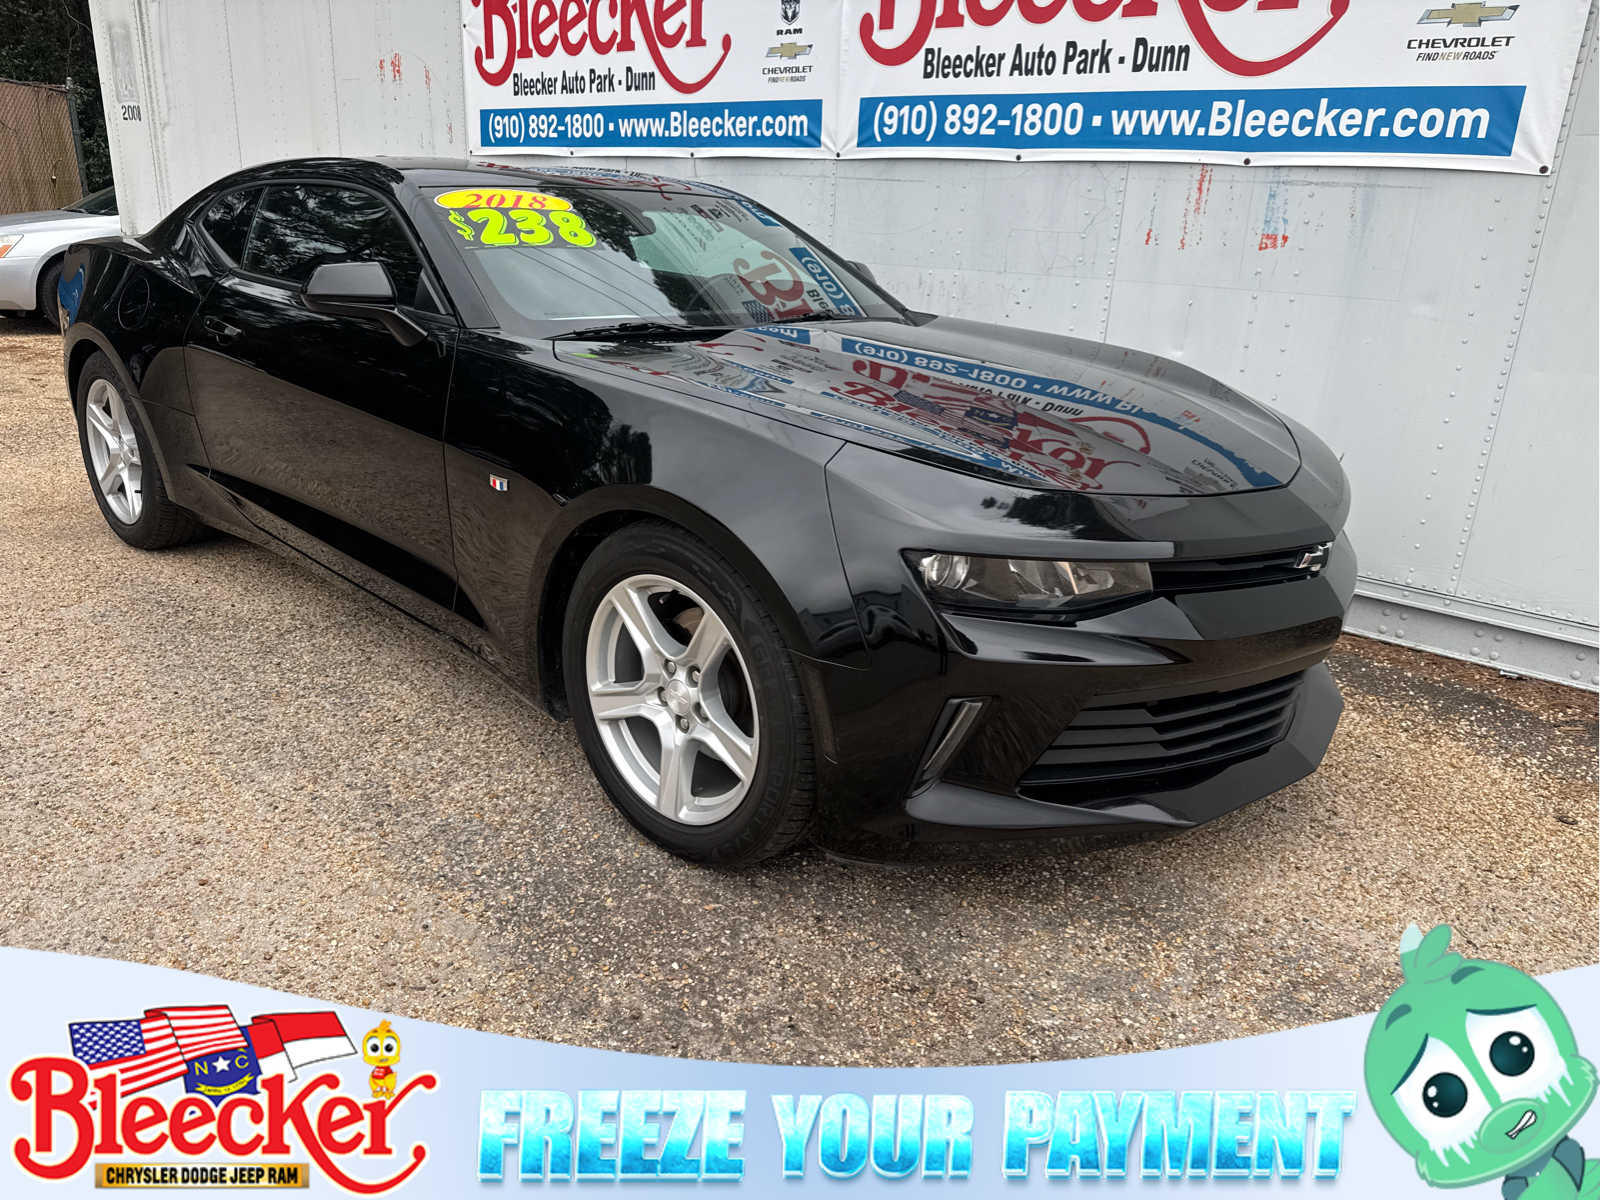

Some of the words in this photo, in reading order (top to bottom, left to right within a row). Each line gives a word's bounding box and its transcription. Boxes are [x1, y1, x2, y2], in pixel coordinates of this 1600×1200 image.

[776, 28, 803, 36] RAM
[1407, 36, 1516, 49] CHEVROLET
[762, 65, 814, 75] CHEVROLET
[923, 46, 1005, 79] Bleecker
[1009, 43, 1057, 77] Auto
[1063, 39, 1114, 75] Park
[1132, 37, 1190, 73] Dunn
[513, 72, 558, 96] Bleecker
[561, 70, 586, 95] Auto
[589, 68, 616, 93] Park
[626, 66, 656, 91] Dunn
[488, 112, 525, 143] (910)
[529, 113, 604, 139] 892-1800
[618, 109, 808, 139] www.Bleecker.com
[873, 100, 937, 142] (910)
[944, 103, 1084, 136] 892-1800
[1111, 98, 1490, 138] www.Bleecker.com
[464, 193, 547, 209] 2018
[448, 208, 597, 247] $238
